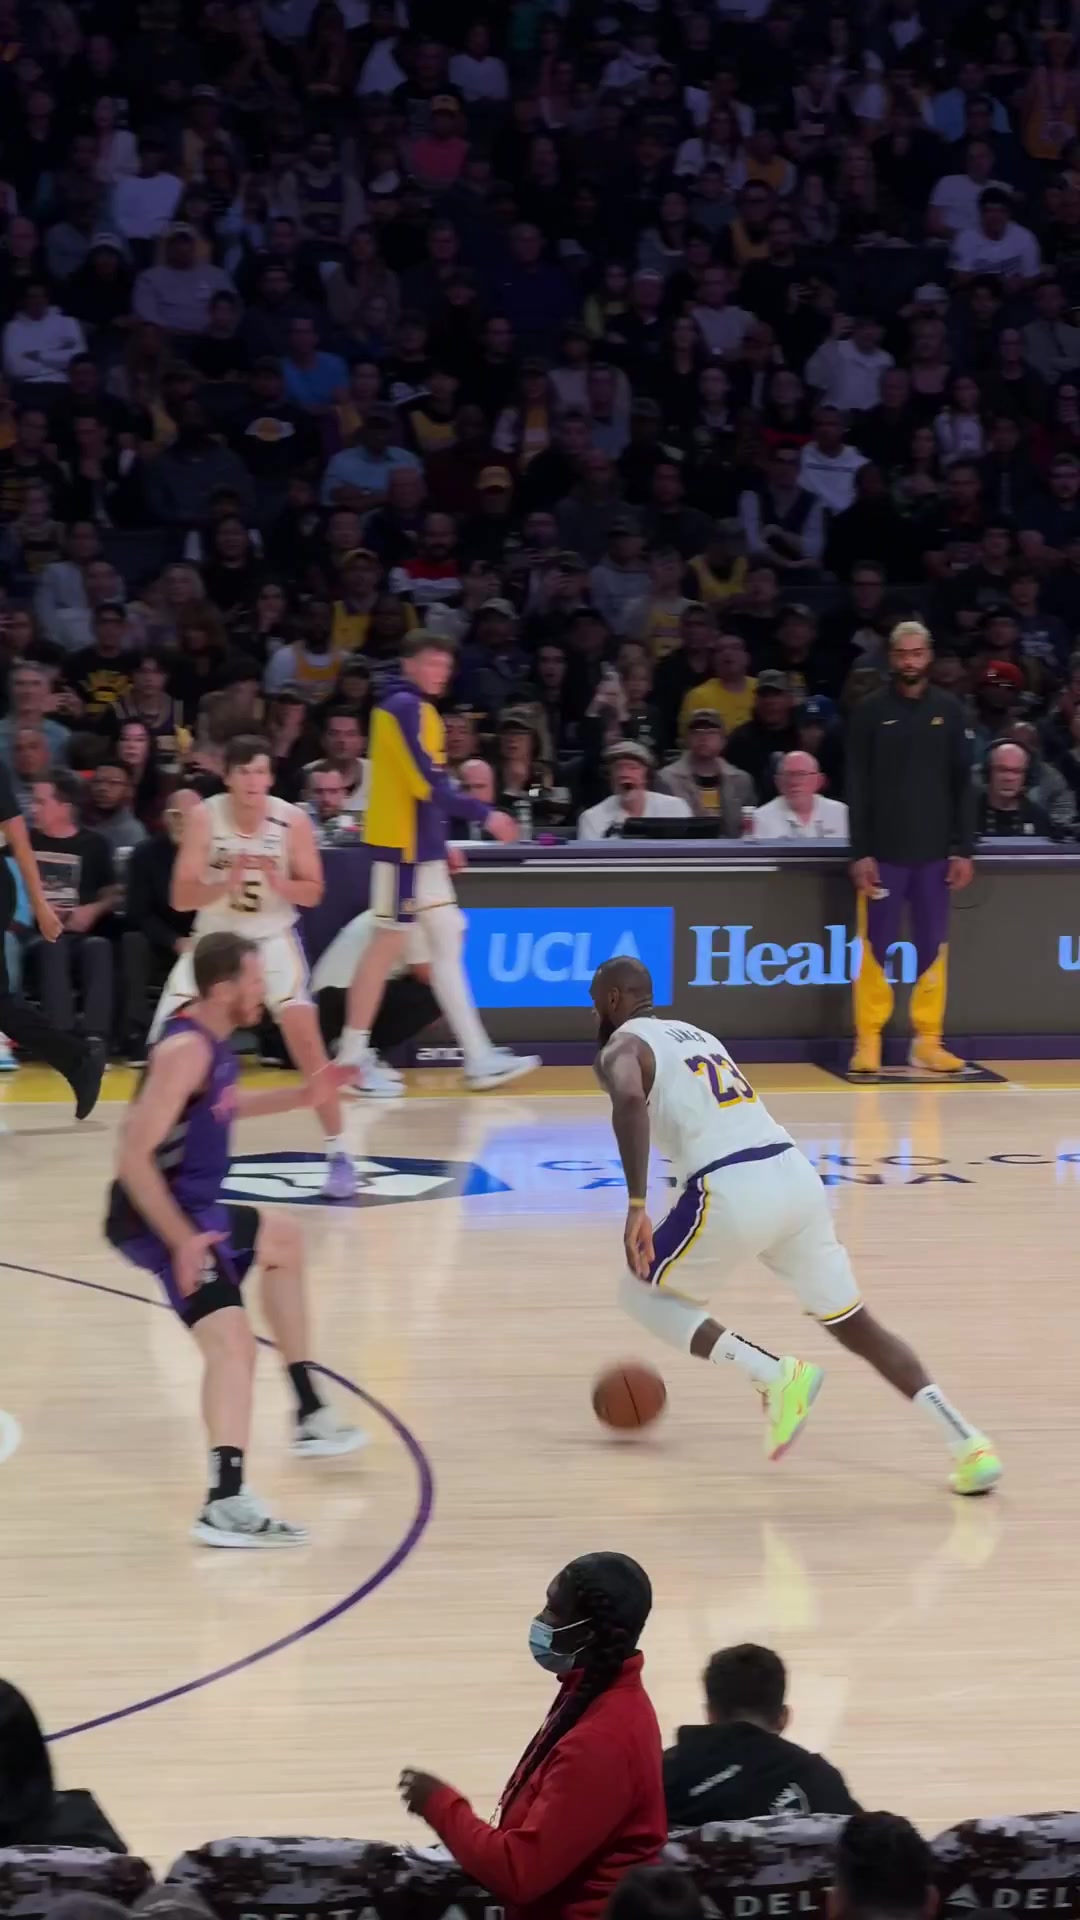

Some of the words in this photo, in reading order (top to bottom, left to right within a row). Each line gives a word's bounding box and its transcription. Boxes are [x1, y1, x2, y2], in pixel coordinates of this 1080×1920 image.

[684, 1053, 759, 1108] 23
[576, 1173, 978, 1190] ANA
[992, 1886, 1080, 1909] DEL
